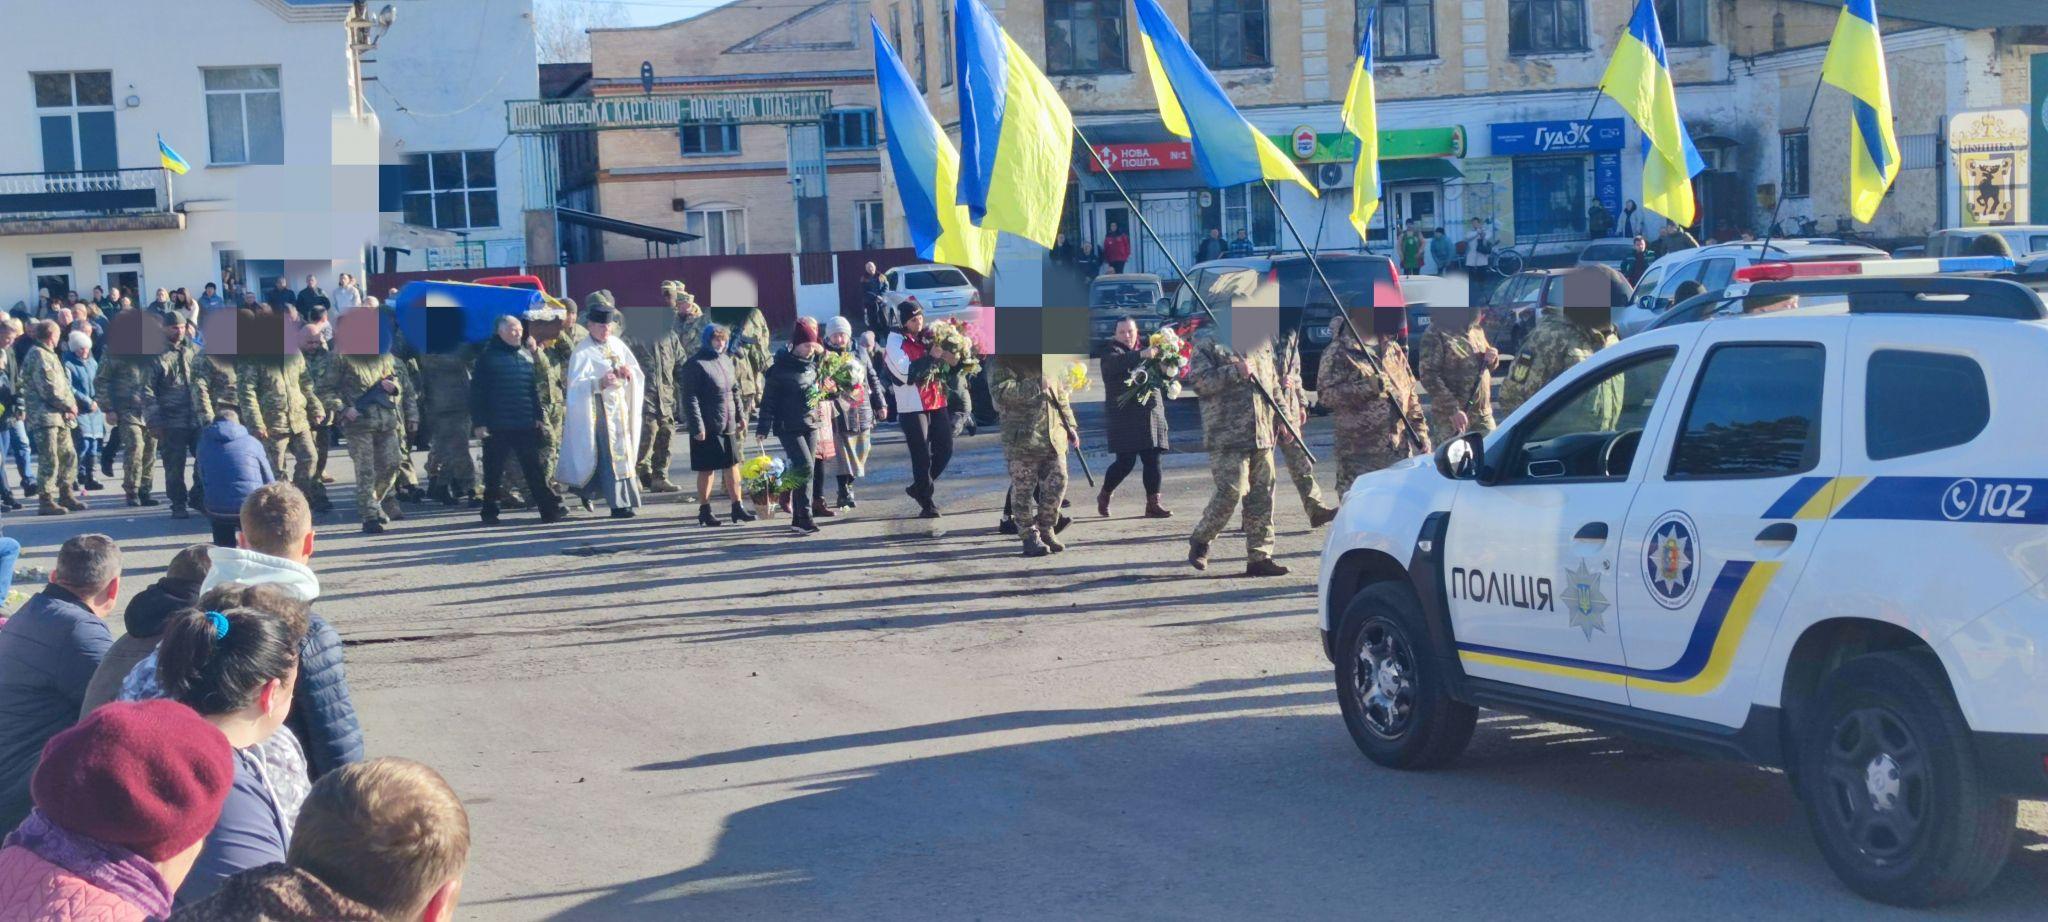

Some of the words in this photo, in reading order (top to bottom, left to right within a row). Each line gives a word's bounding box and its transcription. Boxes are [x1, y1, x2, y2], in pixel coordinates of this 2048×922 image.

[1121, 149, 1150, 158] НОВА
[1121, 158, 1160, 167] ПОШТА
[1979, 484, 2032, 518] 102
[1452, 566, 1554, 612] ПОЛІЦІЯ
